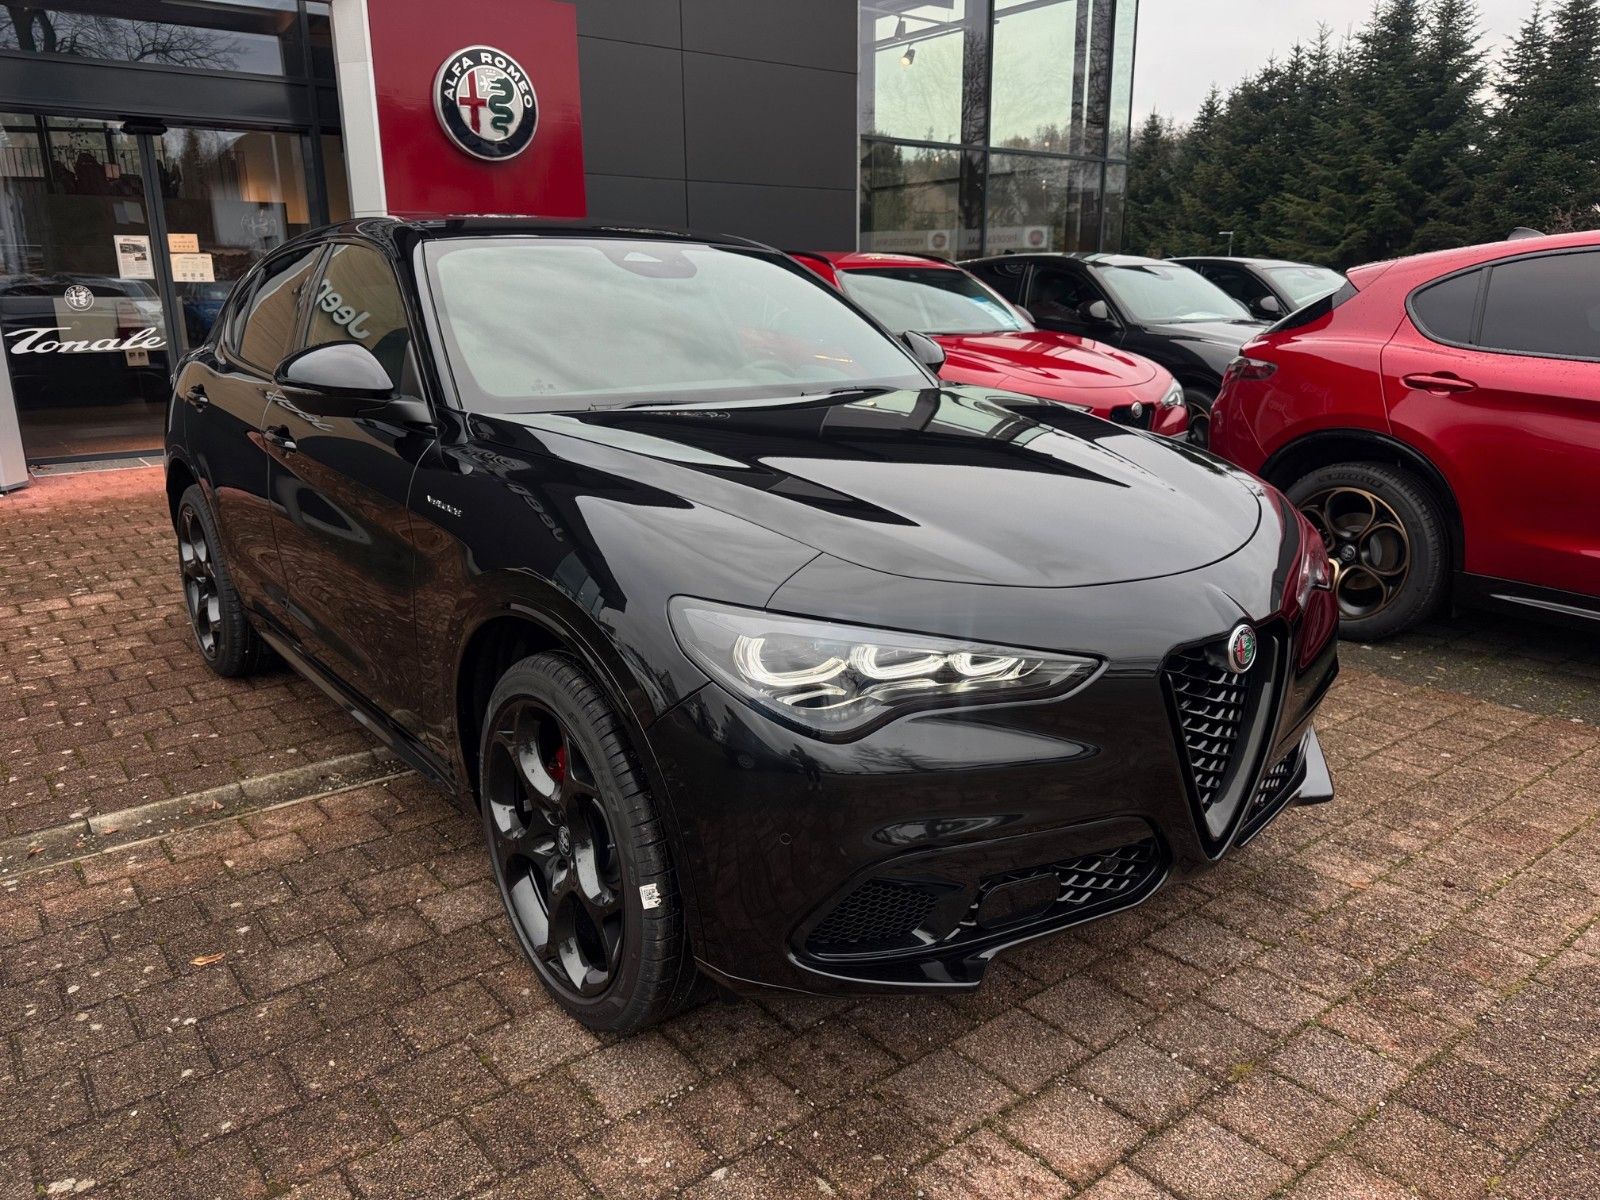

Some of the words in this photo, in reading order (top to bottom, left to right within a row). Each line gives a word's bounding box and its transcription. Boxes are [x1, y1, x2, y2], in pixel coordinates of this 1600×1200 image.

[444, 56, 474, 101] ALFA
[480, 52, 533, 108] ROMEO
[4, 326, 167, 355] Tonale
